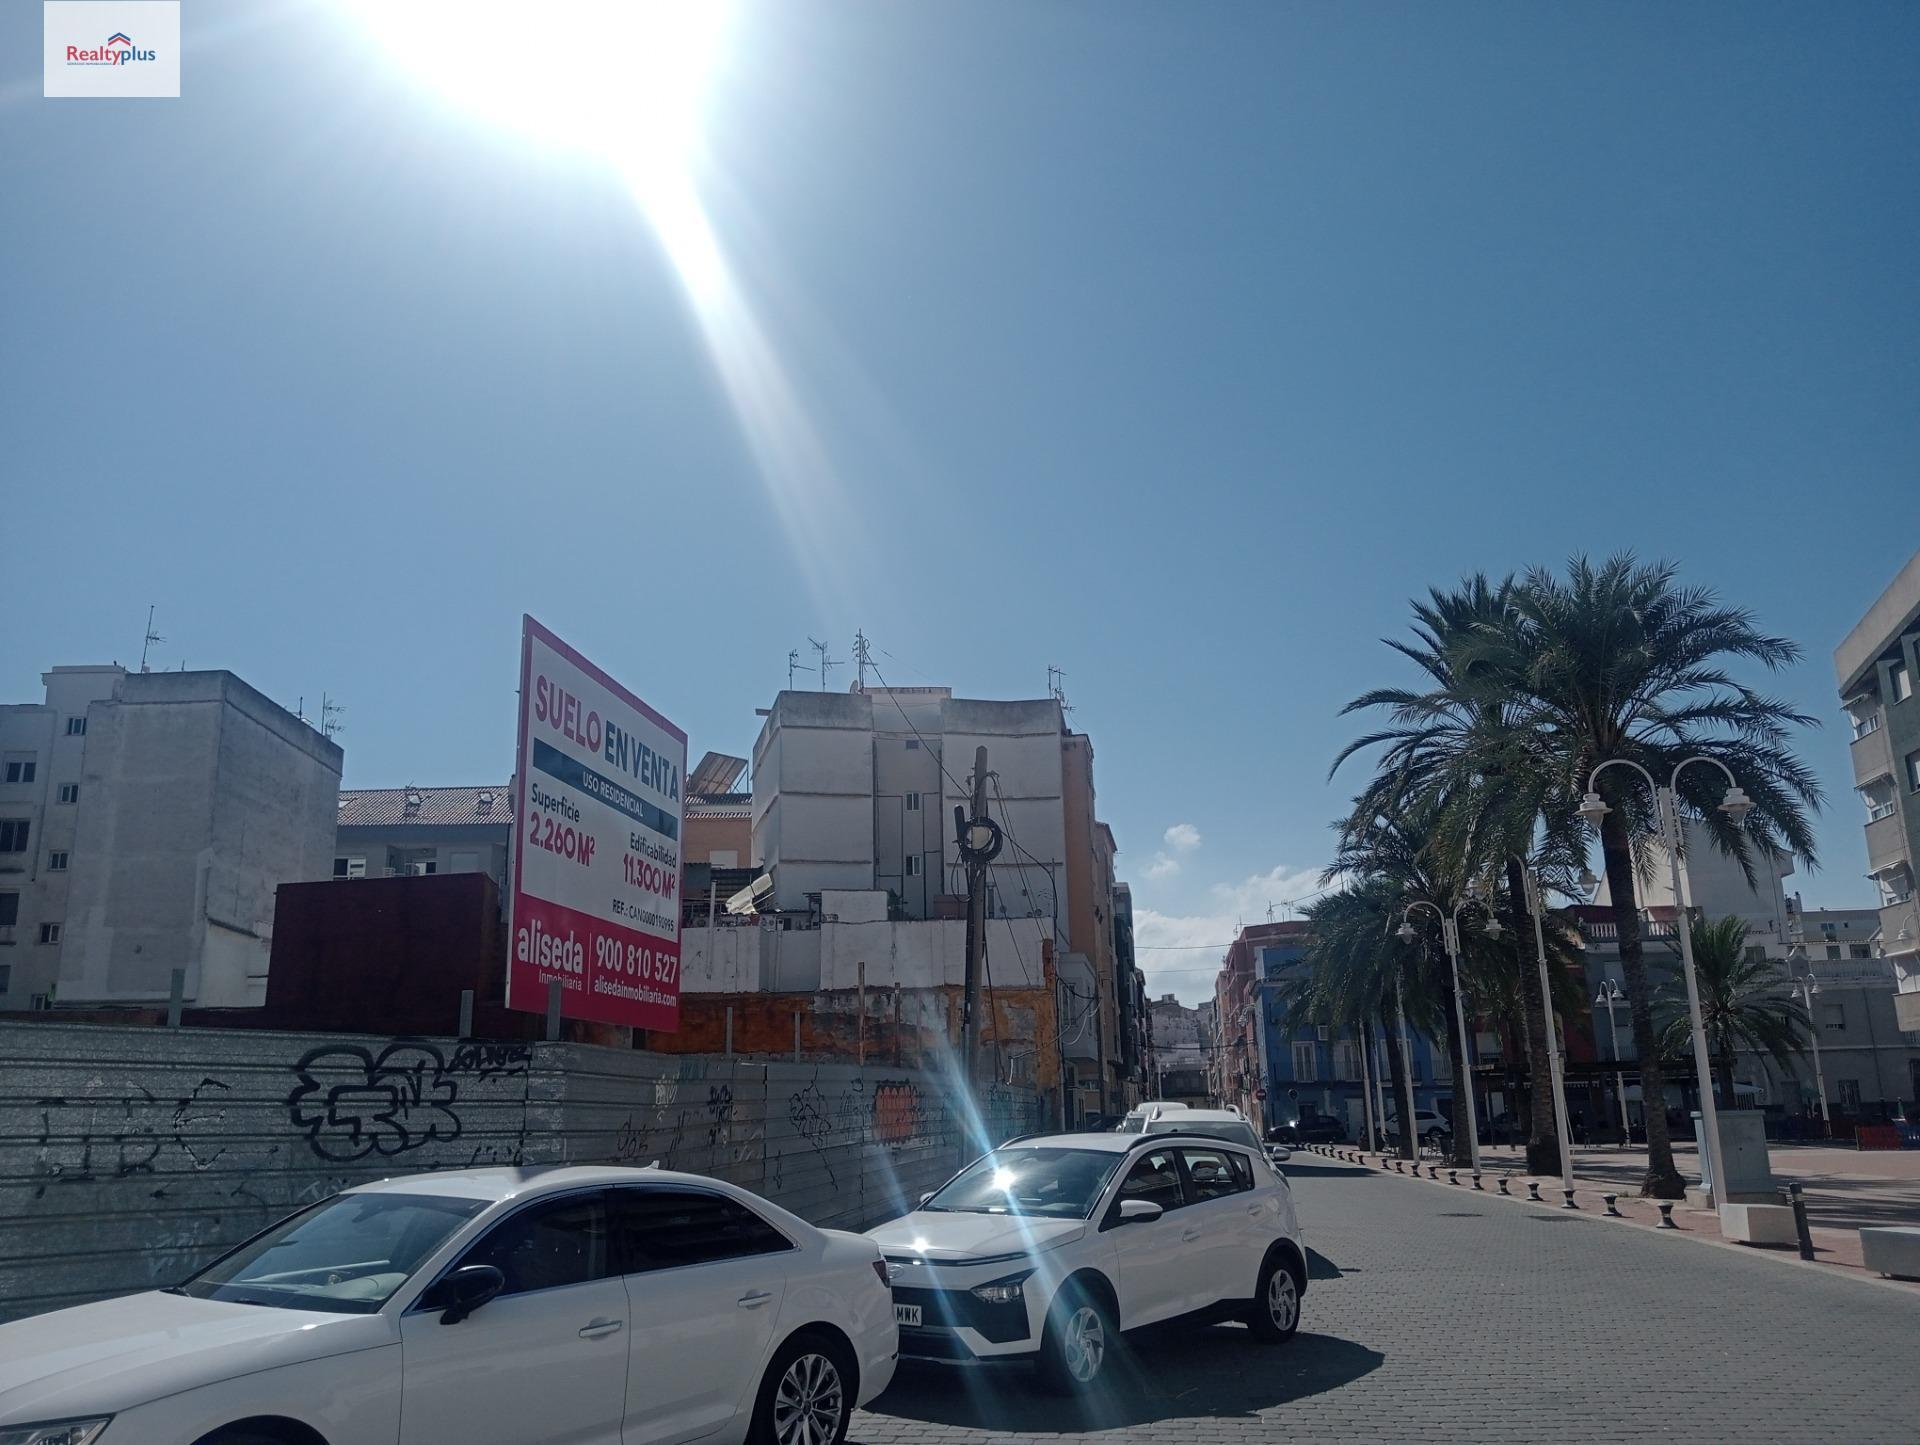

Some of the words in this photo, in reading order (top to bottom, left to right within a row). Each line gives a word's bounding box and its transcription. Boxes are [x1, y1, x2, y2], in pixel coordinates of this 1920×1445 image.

[535, 675, 601, 752] SUELO
[605, 719, 628, 772] EN
[631, 737, 679, 803] VENTA
[532, 783, 579, 822] Superficie
[582, 771, 599, 791] USO
[600, 782, 644, 817] RESIDENCIAL
[630, 832, 677, 868] Edificabilidad
[517, 919, 583, 974] aliseda
[596, 935, 622, 972] 900
[626, 944, 650, 979] 810
[655, 952, 678, 984] 527
[594, 975, 677, 1007] alisedainmobiliaria.com
[896, 1306, 919, 1322] MWK
